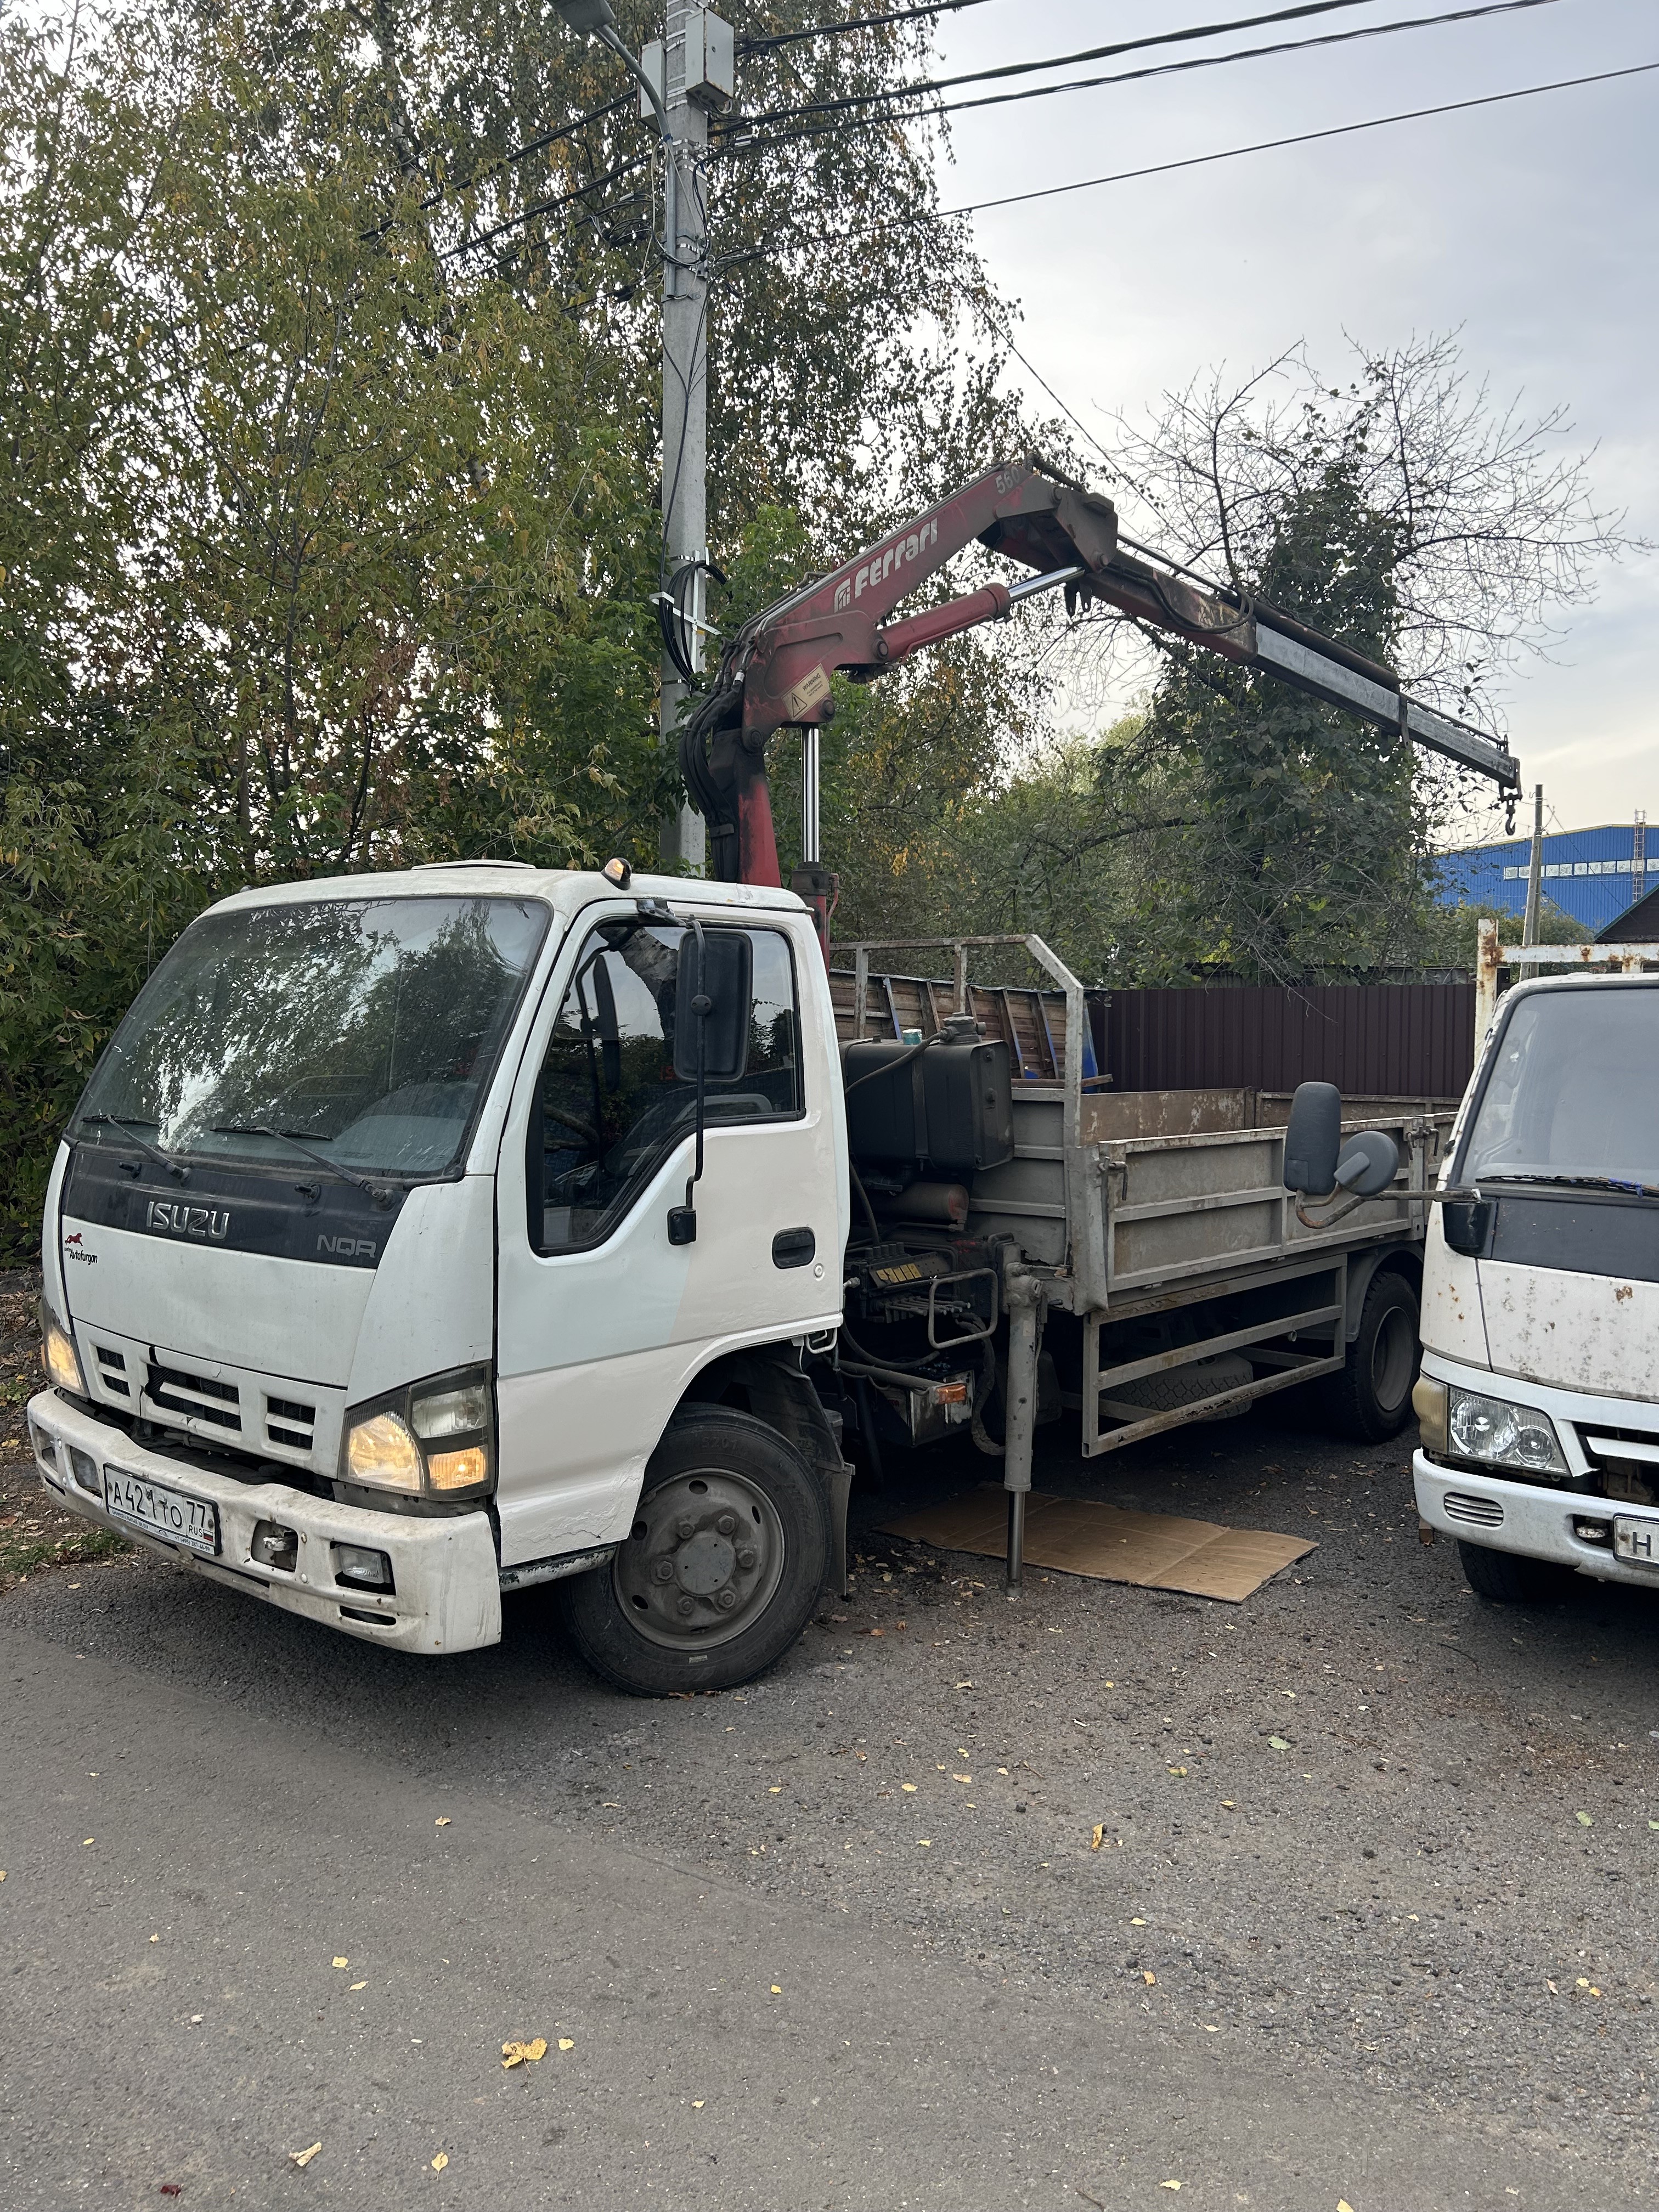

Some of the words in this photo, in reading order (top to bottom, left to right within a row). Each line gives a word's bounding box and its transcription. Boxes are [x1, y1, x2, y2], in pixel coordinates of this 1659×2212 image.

[995, 466, 1020, 494] 560
[855, 517, 938, 599] Ferrari
[803, 673, 821, 691] WARNING
[146, 1201, 230, 1240] ISUZU
[70, 1249, 98, 1266] Avtofurgon
[317, 1234, 377, 1258] NQR
[186, 1500, 206, 1528] 77
[188, 1525, 202, 1537] RUS
